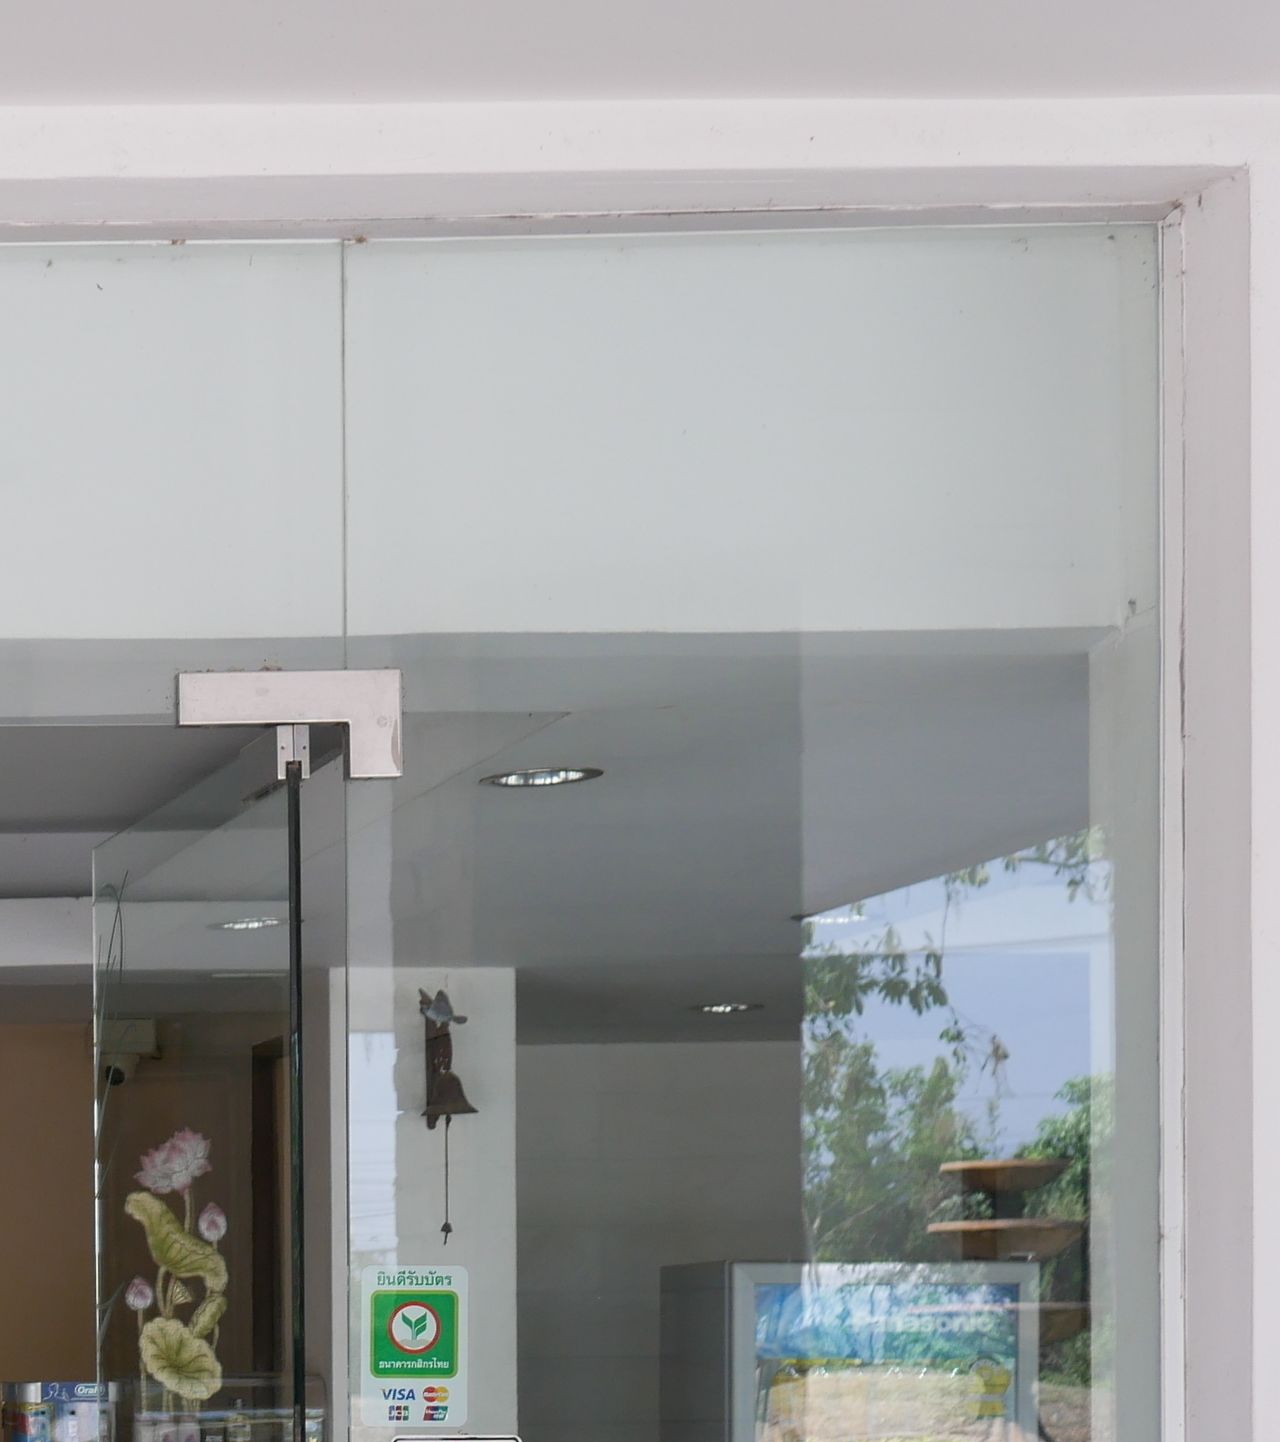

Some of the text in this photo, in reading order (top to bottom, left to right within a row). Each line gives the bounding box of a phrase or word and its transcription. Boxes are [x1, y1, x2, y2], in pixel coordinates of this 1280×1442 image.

[376, 1270, 453, 1286] ยินดีรับบัตร
[382, 1388, 416, 1401] VISA
